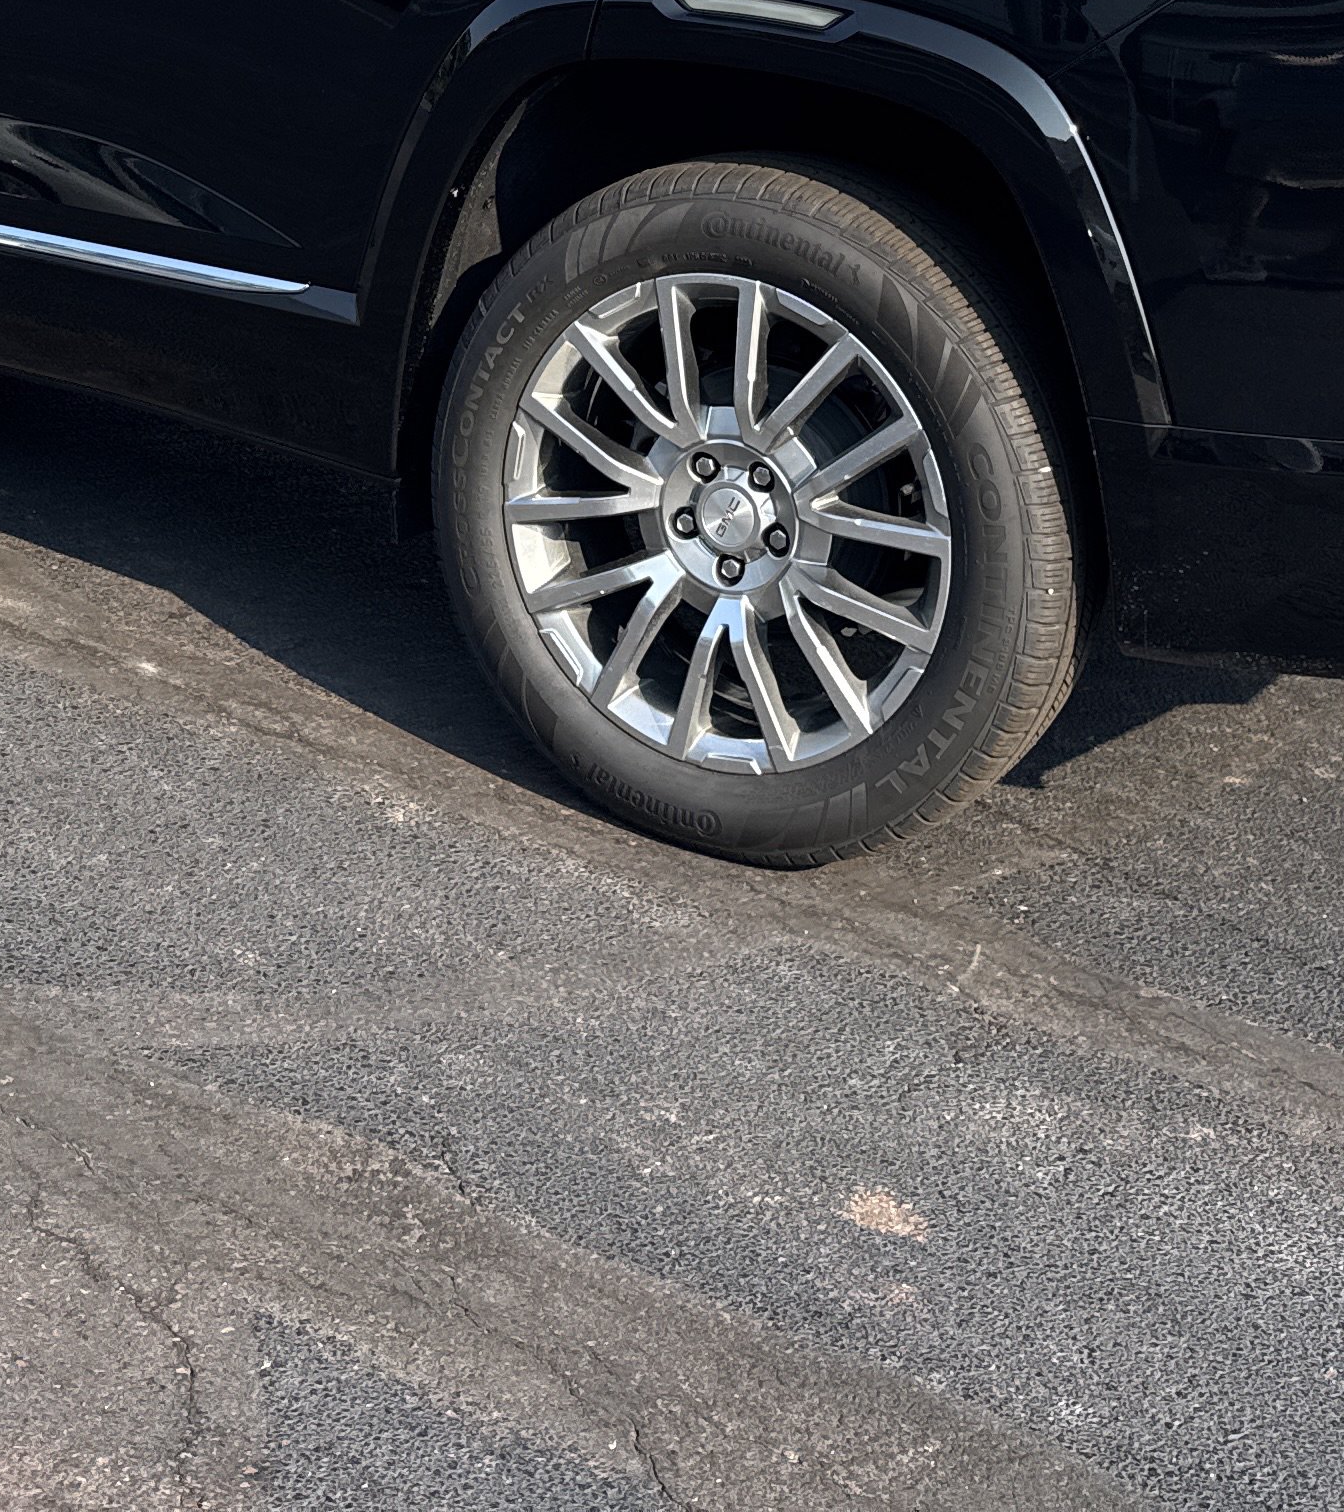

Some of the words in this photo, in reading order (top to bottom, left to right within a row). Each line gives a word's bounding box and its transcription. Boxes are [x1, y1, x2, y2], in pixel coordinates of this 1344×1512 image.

[700, 210, 847, 277] Continental
[715, 496, 741, 538] GMC
[875, 441, 1008, 794] CONTINENTAL
